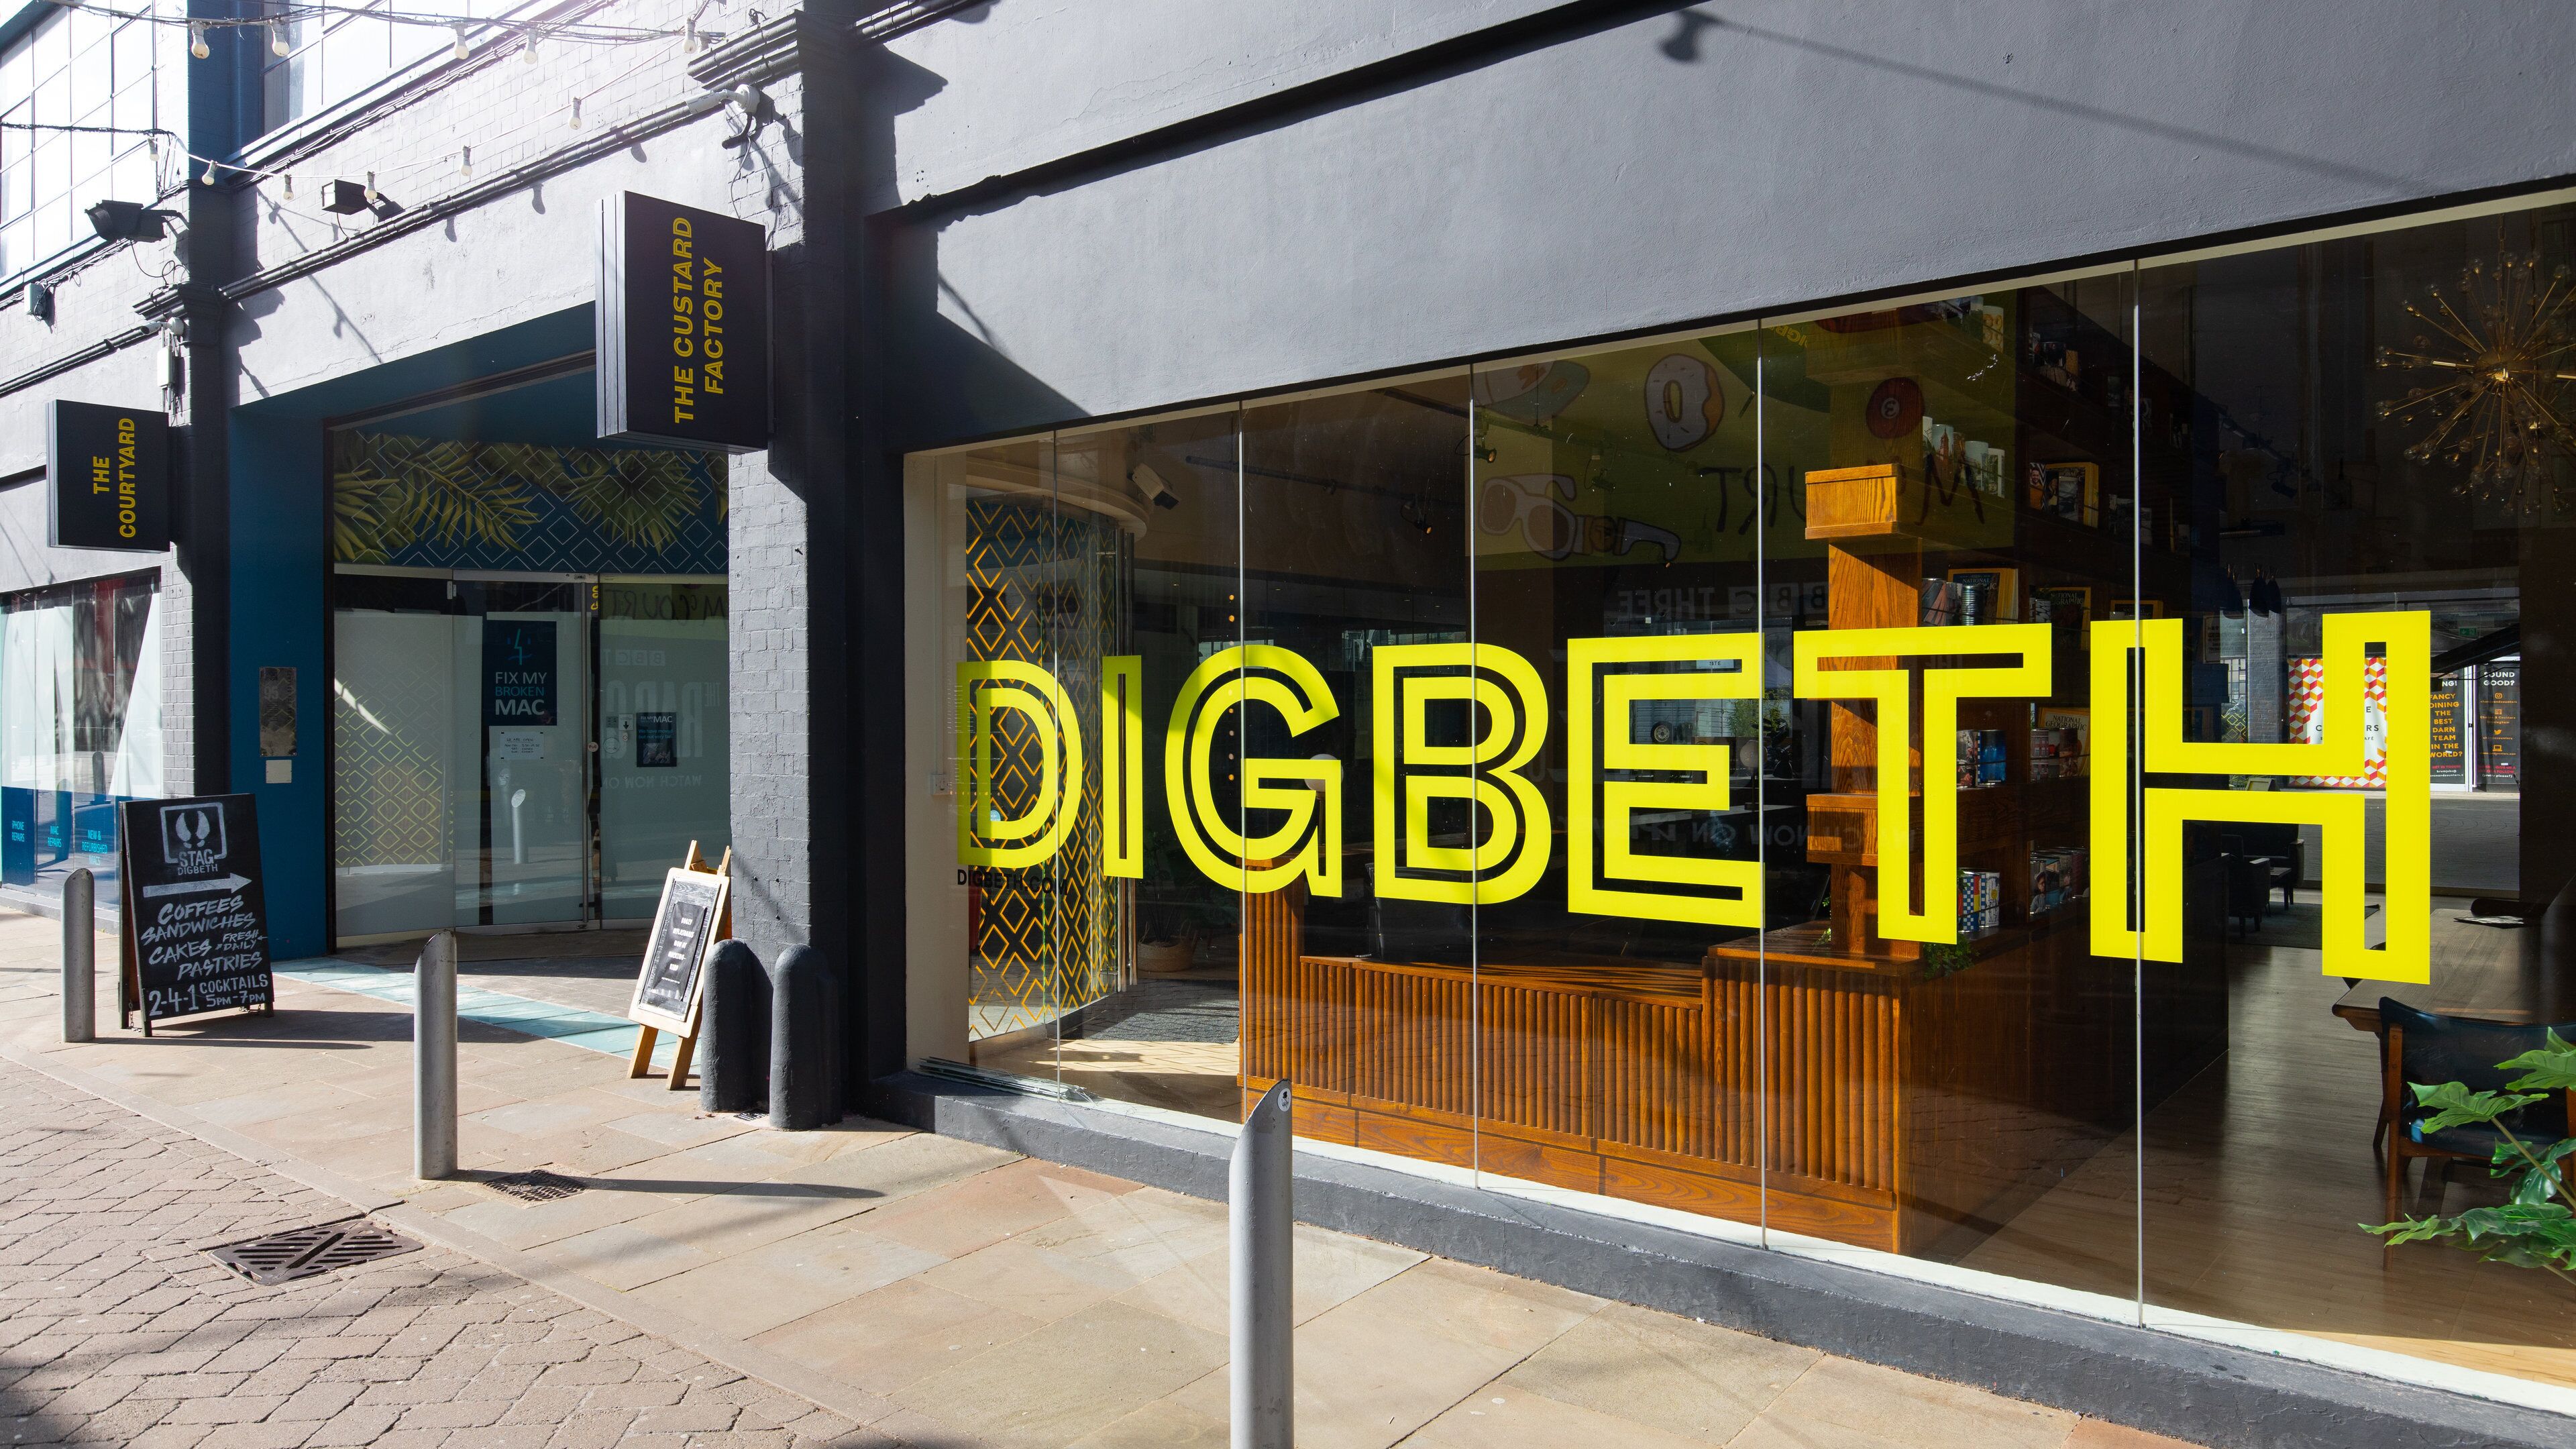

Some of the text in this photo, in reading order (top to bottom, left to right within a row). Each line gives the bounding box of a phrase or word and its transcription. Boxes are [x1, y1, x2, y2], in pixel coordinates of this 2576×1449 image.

[673, 217, 694, 424] THE CUSTARD
[703, 257, 723, 394] FACTORY
[93, 456, 110, 494] THE
[118, 418, 136, 538] COURTYARD
[495, 672, 547, 684] FIX MY
[495, 686, 545, 696] BROKEN
[495, 699, 545, 715] MAC
[2053, 715, 2082, 724] NATIONAL
[957, 610, 2431, 985] DIGBETH
[12, 832, 25, 843] REPAIRS
[50, 825, 59, 835] MAC
[87, 830, 101, 840] NEW &
[47, 837, 62, 848] REPAIRS
[82, 841, 108, 853] REFURBISHED
[178, 849, 214, 867] STAG
[177, 863, 218, 875] DIGBETH
[957, 869, 1069, 896] DIGBETH.COM
[158, 895, 244, 925] COFFEES
[141, 912, 256, 946] SANDWICHES
[223, 930, 259, 943] FRESH
[149, 939, 212, 965] CAKES
[223, 939, 257, 951] DAILY
[177, 951, 263, 981] PASTRIES
[149, 974, 268, 1016] 2-4-1 COCKTAILS
